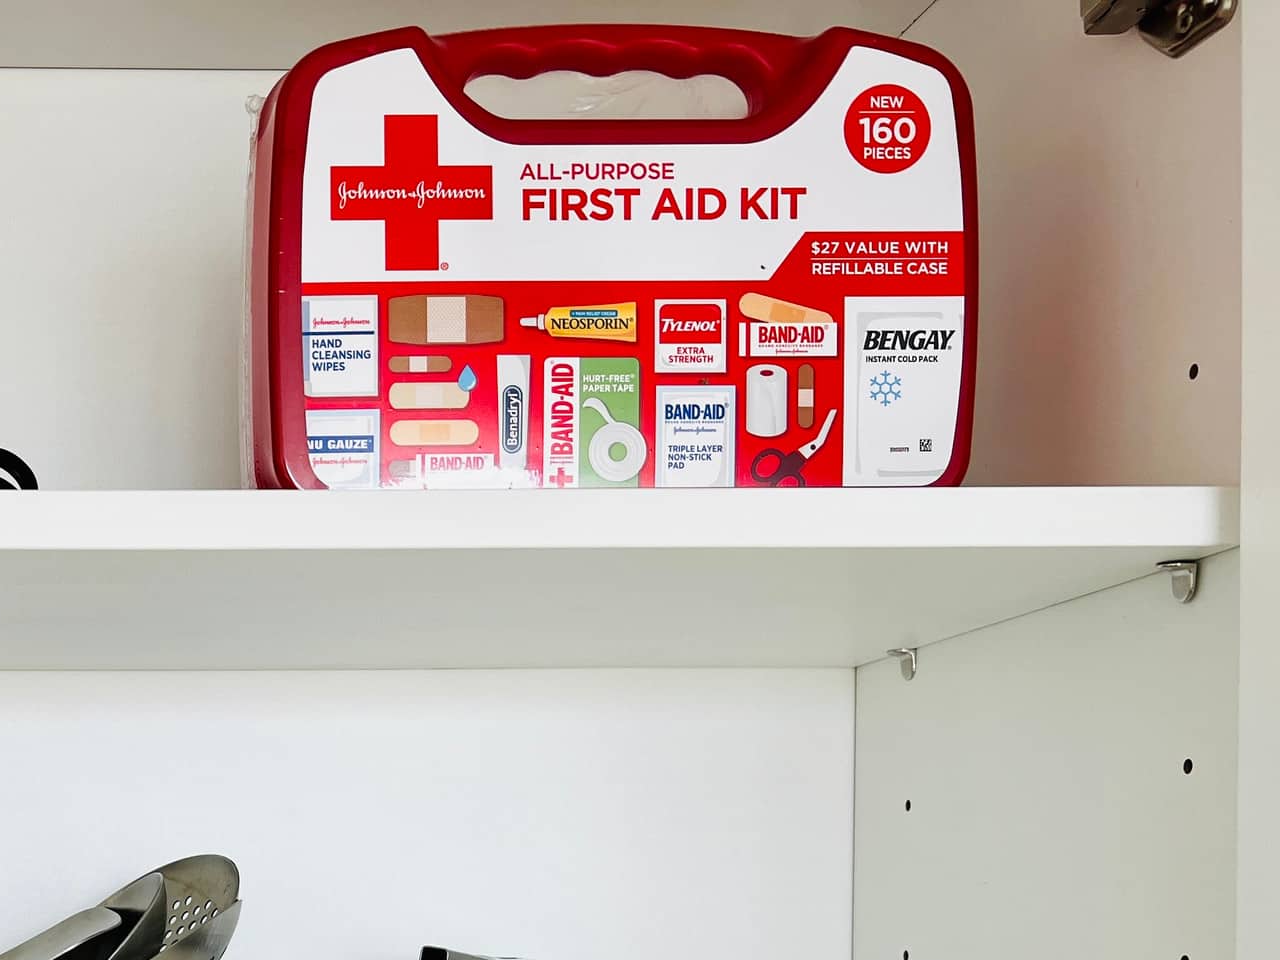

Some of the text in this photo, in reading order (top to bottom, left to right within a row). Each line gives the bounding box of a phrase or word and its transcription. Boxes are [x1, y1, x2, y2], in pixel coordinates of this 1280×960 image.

[869, 95, 904, 109] NEW
[858, 117, 917, 144] 160
[863, 147, 912, 160] PIECES
[519, 163, 675, 180] ALL-PURPOSE
[521, 186, 808, 221] FIRST AID KIT
[811, 241, 949, 255] $27 VALUE WITH
[811, 262, 948, 275] REFILLABLE CASE
[551, 318, 629, 330] NEOSPORIN
[660, 318, 717, 333] TYLENOL
[312, 338, 343, 349] HAND
[863, 330, 956, 350] BENGAY
[311, 350, 372, 360] CLEANSING
[676, 346, 705, 355] EXTRA
[668, 355, 714, 363] STRENGTH
[865, 355, 939, 363] INSTANT COLD PACK
[312, 361, 346, 371] WIPES
[582, 374, 631, 383] HURT-FREE
[582, 384, 635, 392] PAPER TAPE
[506, 393, 522, 446] Benadryl
[327, 439, 368, 450] GAUZE
[668, 445, 723, 453] TRIPLE LAYER
[668, 453, 712, 461] NON-STICK
[667, 461, 685, 469] PAD
